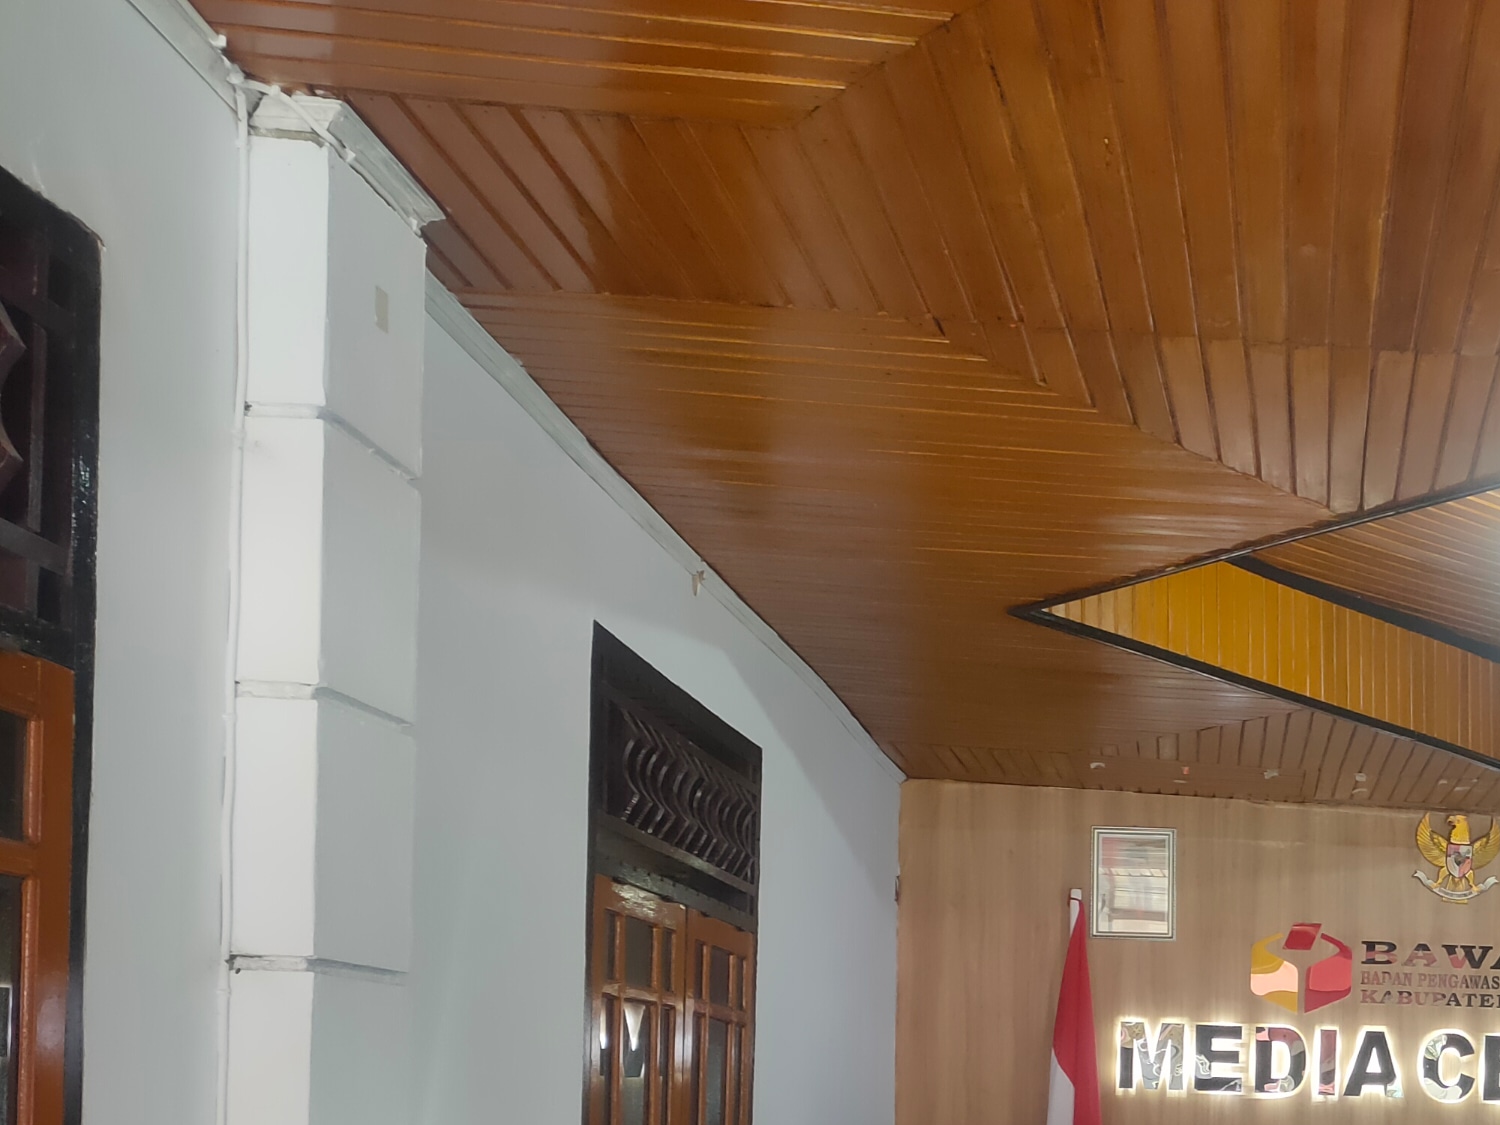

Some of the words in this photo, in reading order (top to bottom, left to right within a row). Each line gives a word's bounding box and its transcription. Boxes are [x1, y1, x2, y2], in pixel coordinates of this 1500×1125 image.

[1360, 970, 1412, 987] BADAN
[1417, 972, 1500, 990] PENGAWAS
[1118, 1021, 1404, 1098] MEDIA
